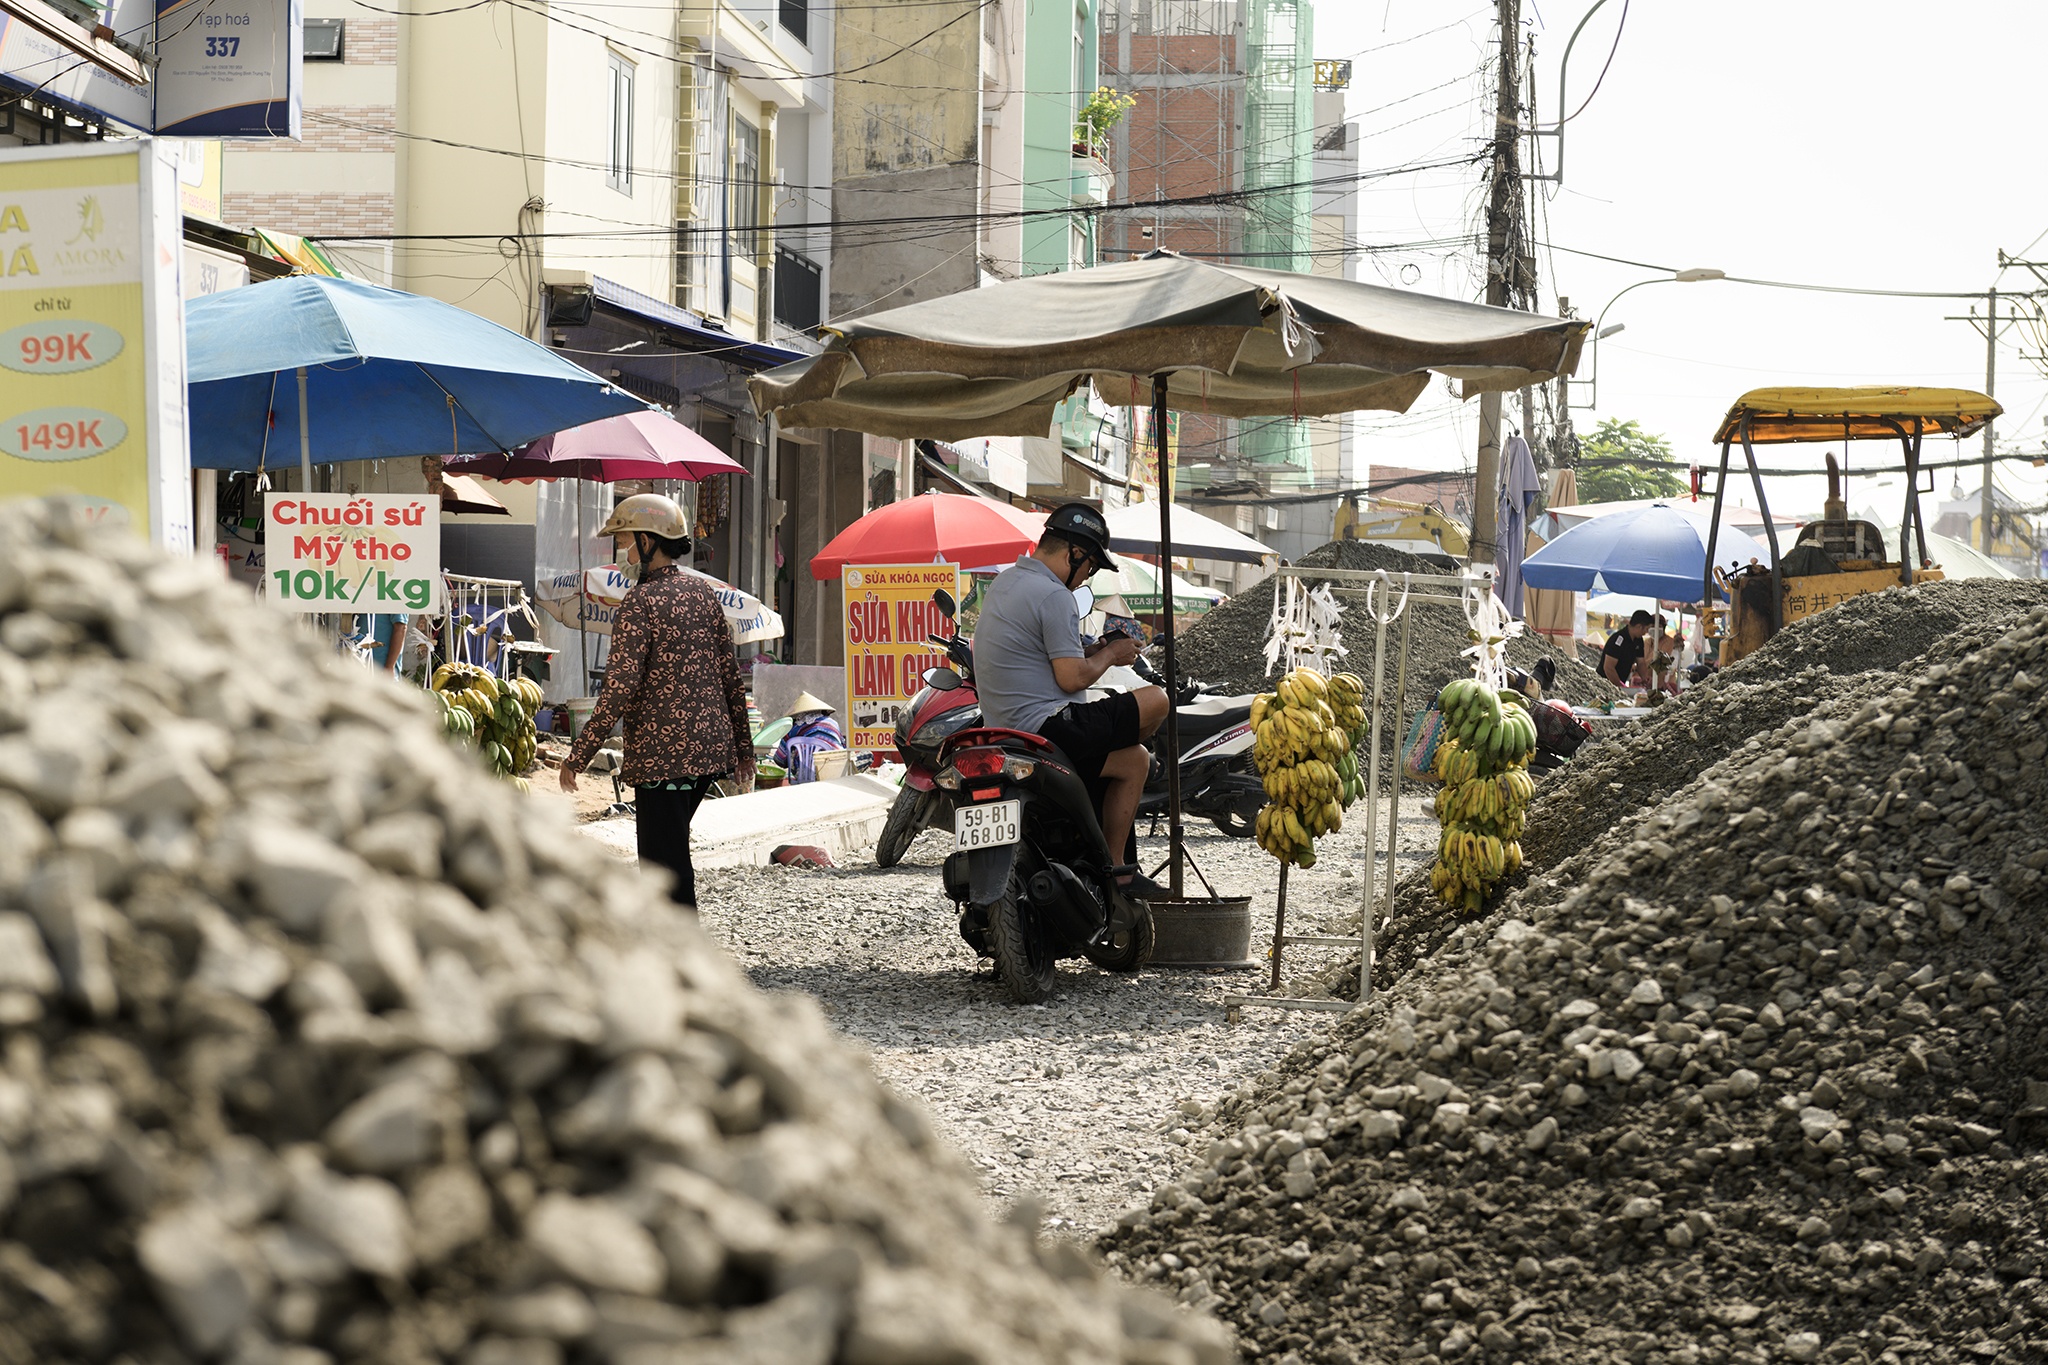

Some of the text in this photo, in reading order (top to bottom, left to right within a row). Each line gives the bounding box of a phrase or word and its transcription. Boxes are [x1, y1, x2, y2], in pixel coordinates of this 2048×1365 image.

[199, 12, 250, 28] Tạp hoá
[205, 36, 240, 57] 337
[200, 262, 219, 294] 337
[34, 297, 72, 312] chỉ từ
[20, 332, 93, 365] 99K
[16, 419, 105, 452] 149K
[272, 498, 426, 526] Chuối sứ
[293, 536, 412, 566] Mỹ tho
[273, 566, 431, 610] 10k/kg
[865, 570, 954, 586] SỬA KHÓA NGỌC
[714, 590, 745, 610] all's
[849, 591, 892, 644] SỬA
[852, 647, 951, 698] LÀM CH
[855, 732, 874, 746] ĐT:
[1213, 728, 1245, 747] ULTIMO
[965, 804, 1008, 828] 59-B1
[959, 823, 1016, 847] 468.09
